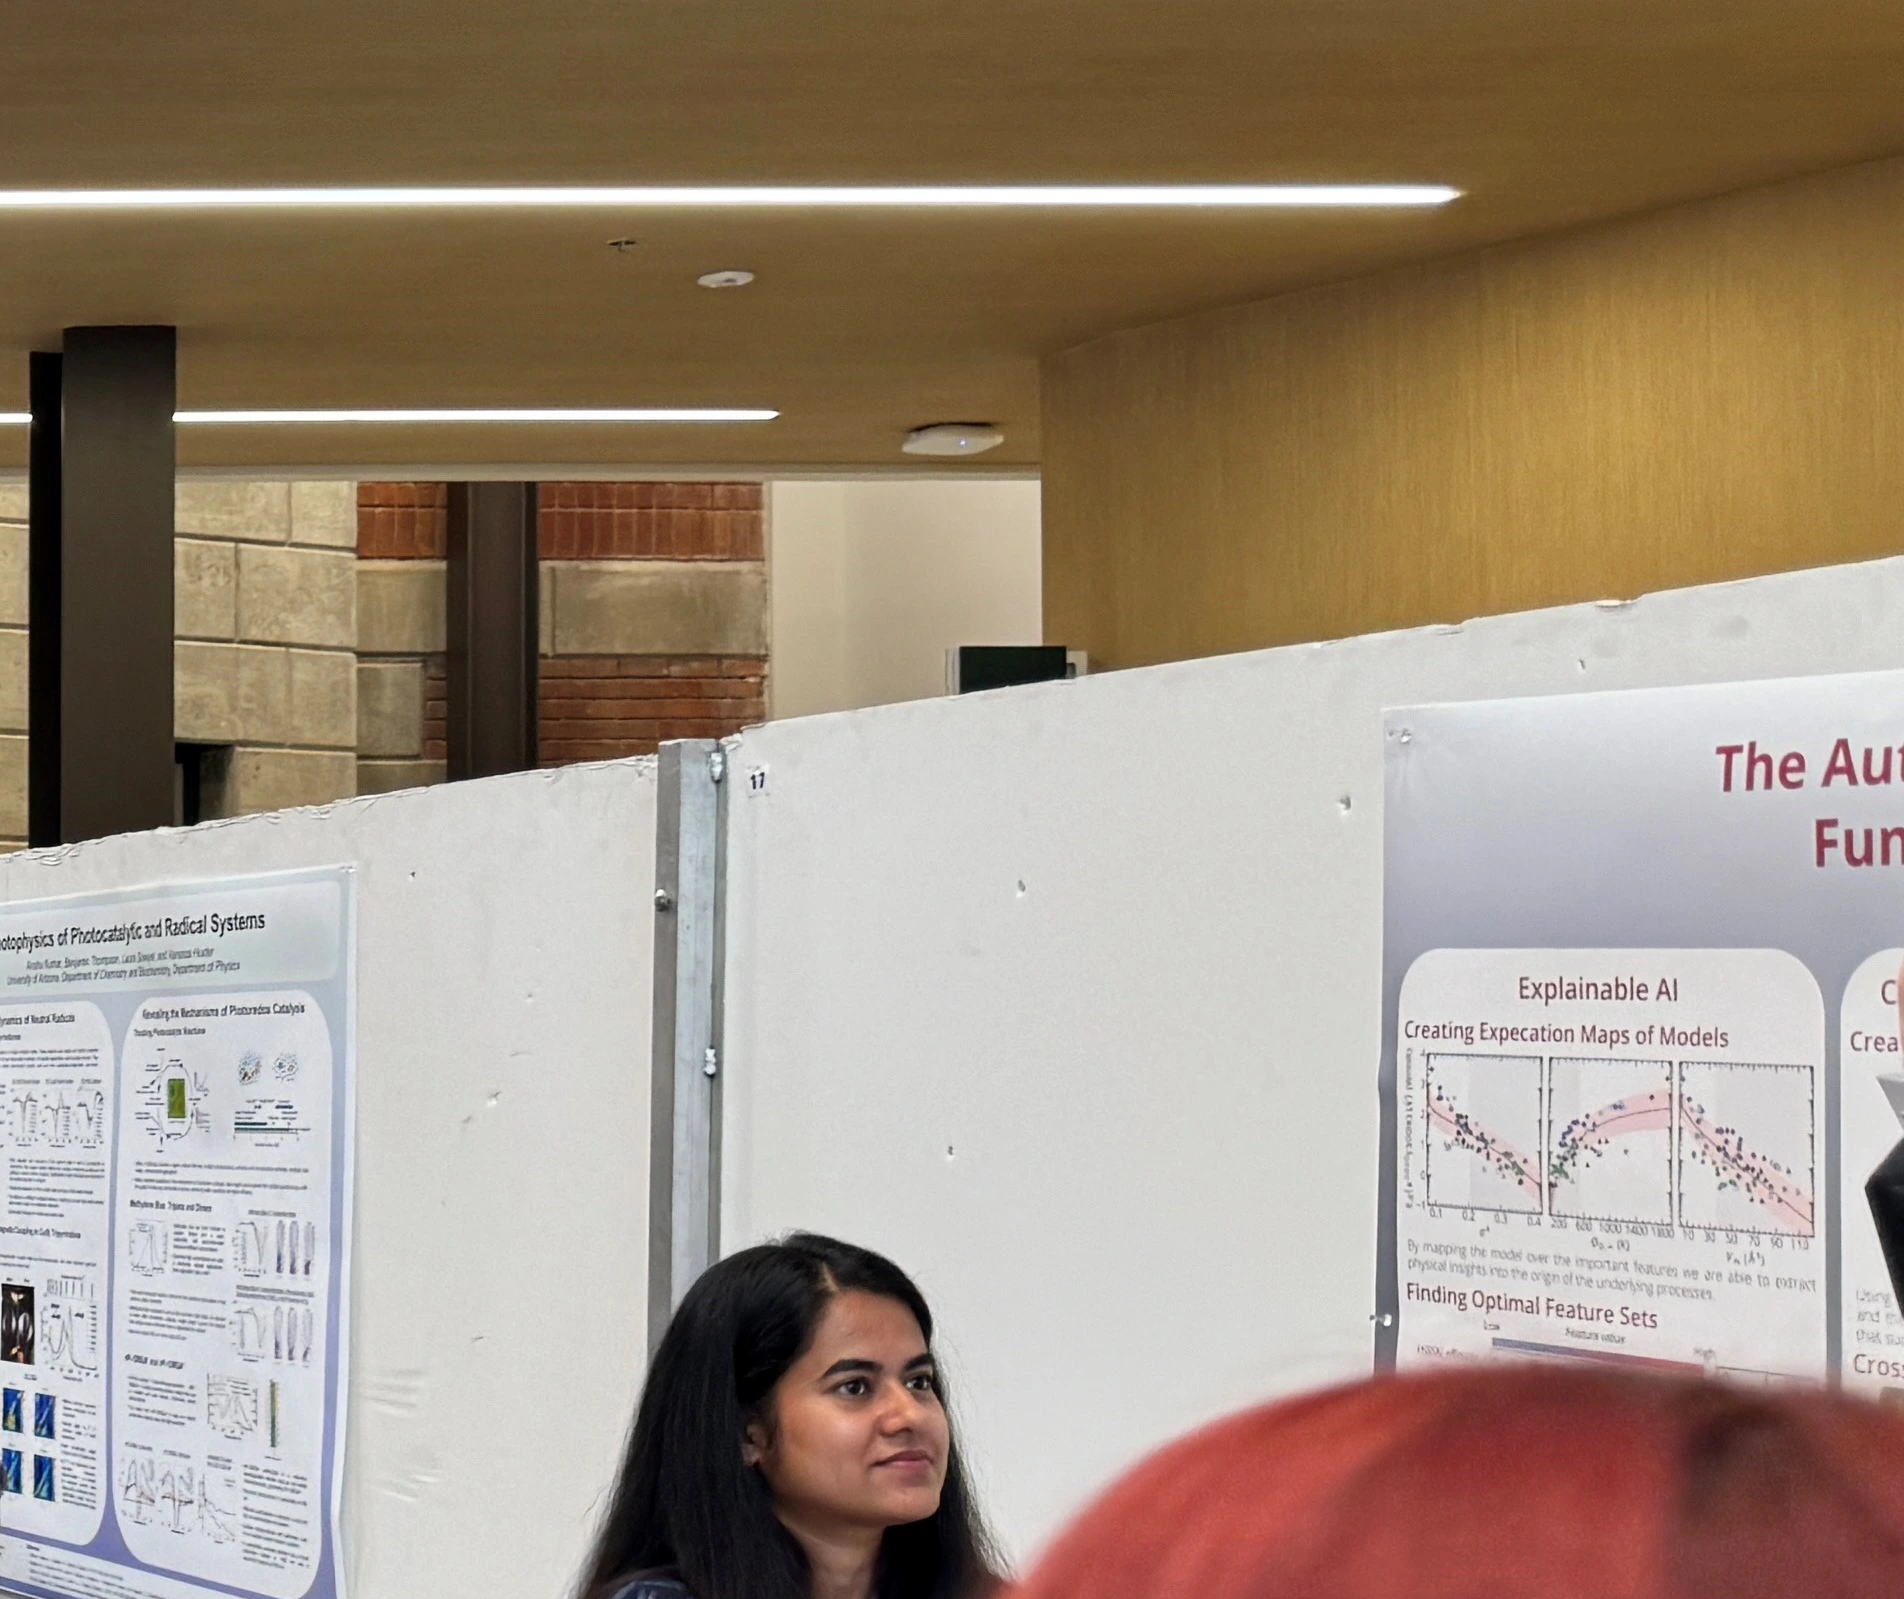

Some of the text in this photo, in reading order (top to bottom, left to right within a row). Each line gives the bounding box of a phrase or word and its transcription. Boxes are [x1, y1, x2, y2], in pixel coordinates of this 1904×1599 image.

[1715, 741, 1806, 792] The
[57, 927, 68, 947] of
[70, 922, 142, 946] Photocatalytic
[144, 919, 162, 940] and
[164, 914, 207, 938] Radical
[210, 912, 265, 938] Systems
[215, 959, 241, 973] Physics
[1519, 975, 1678, 1006] Explainable AI
[220, 1004, 228, 1017] of
[272, 1001, 306, 1017] Catalysis
[1404, 1019, 1729, 1050] Creating Expecation Maps of Models
[1850, 1030, 1898, 1053] Crea
[1429, 1207, 1443, 1219] 0.1
[1462, 1210, 1475, 1223] 0.2
[1527, 1214, 1542, 1227] 0.4
[1407, 1238, 1418, 1255] By
[1423, 1241, 1467, 1260] mapping
[1470, 1244, 1487, 1258] the
[1491, 1247, 1524, 1262] model
[1526, 1251, 1548, 1264] over
[1553, 1253, 1571, 1267] the
[1575, 1255, 1629, 1273] important
[1633, 1259, 1678, 1278] features
[1682, 1268, 1699, 1280] we
[1727, 1270, 1753, 1285] able
[1408, 1257, 1447, 1274] physical
[1448, 1261, 1487, 1279] insights
[1489, 1264, 1509, 1278] into
[1511, 1266, 1528, 1280] the
[1530, 1270, 1560, 1287] origin
[1561, 1271, 1573, 1286] of
[1575, 1273, 1594, 1289] the
[1596, 1277, 1653, 1298] underlying
[1406, 1281, 1658, 1329] Finding Optimal Feature Sets
[1854, 1353, 1904, 1378] Cros
